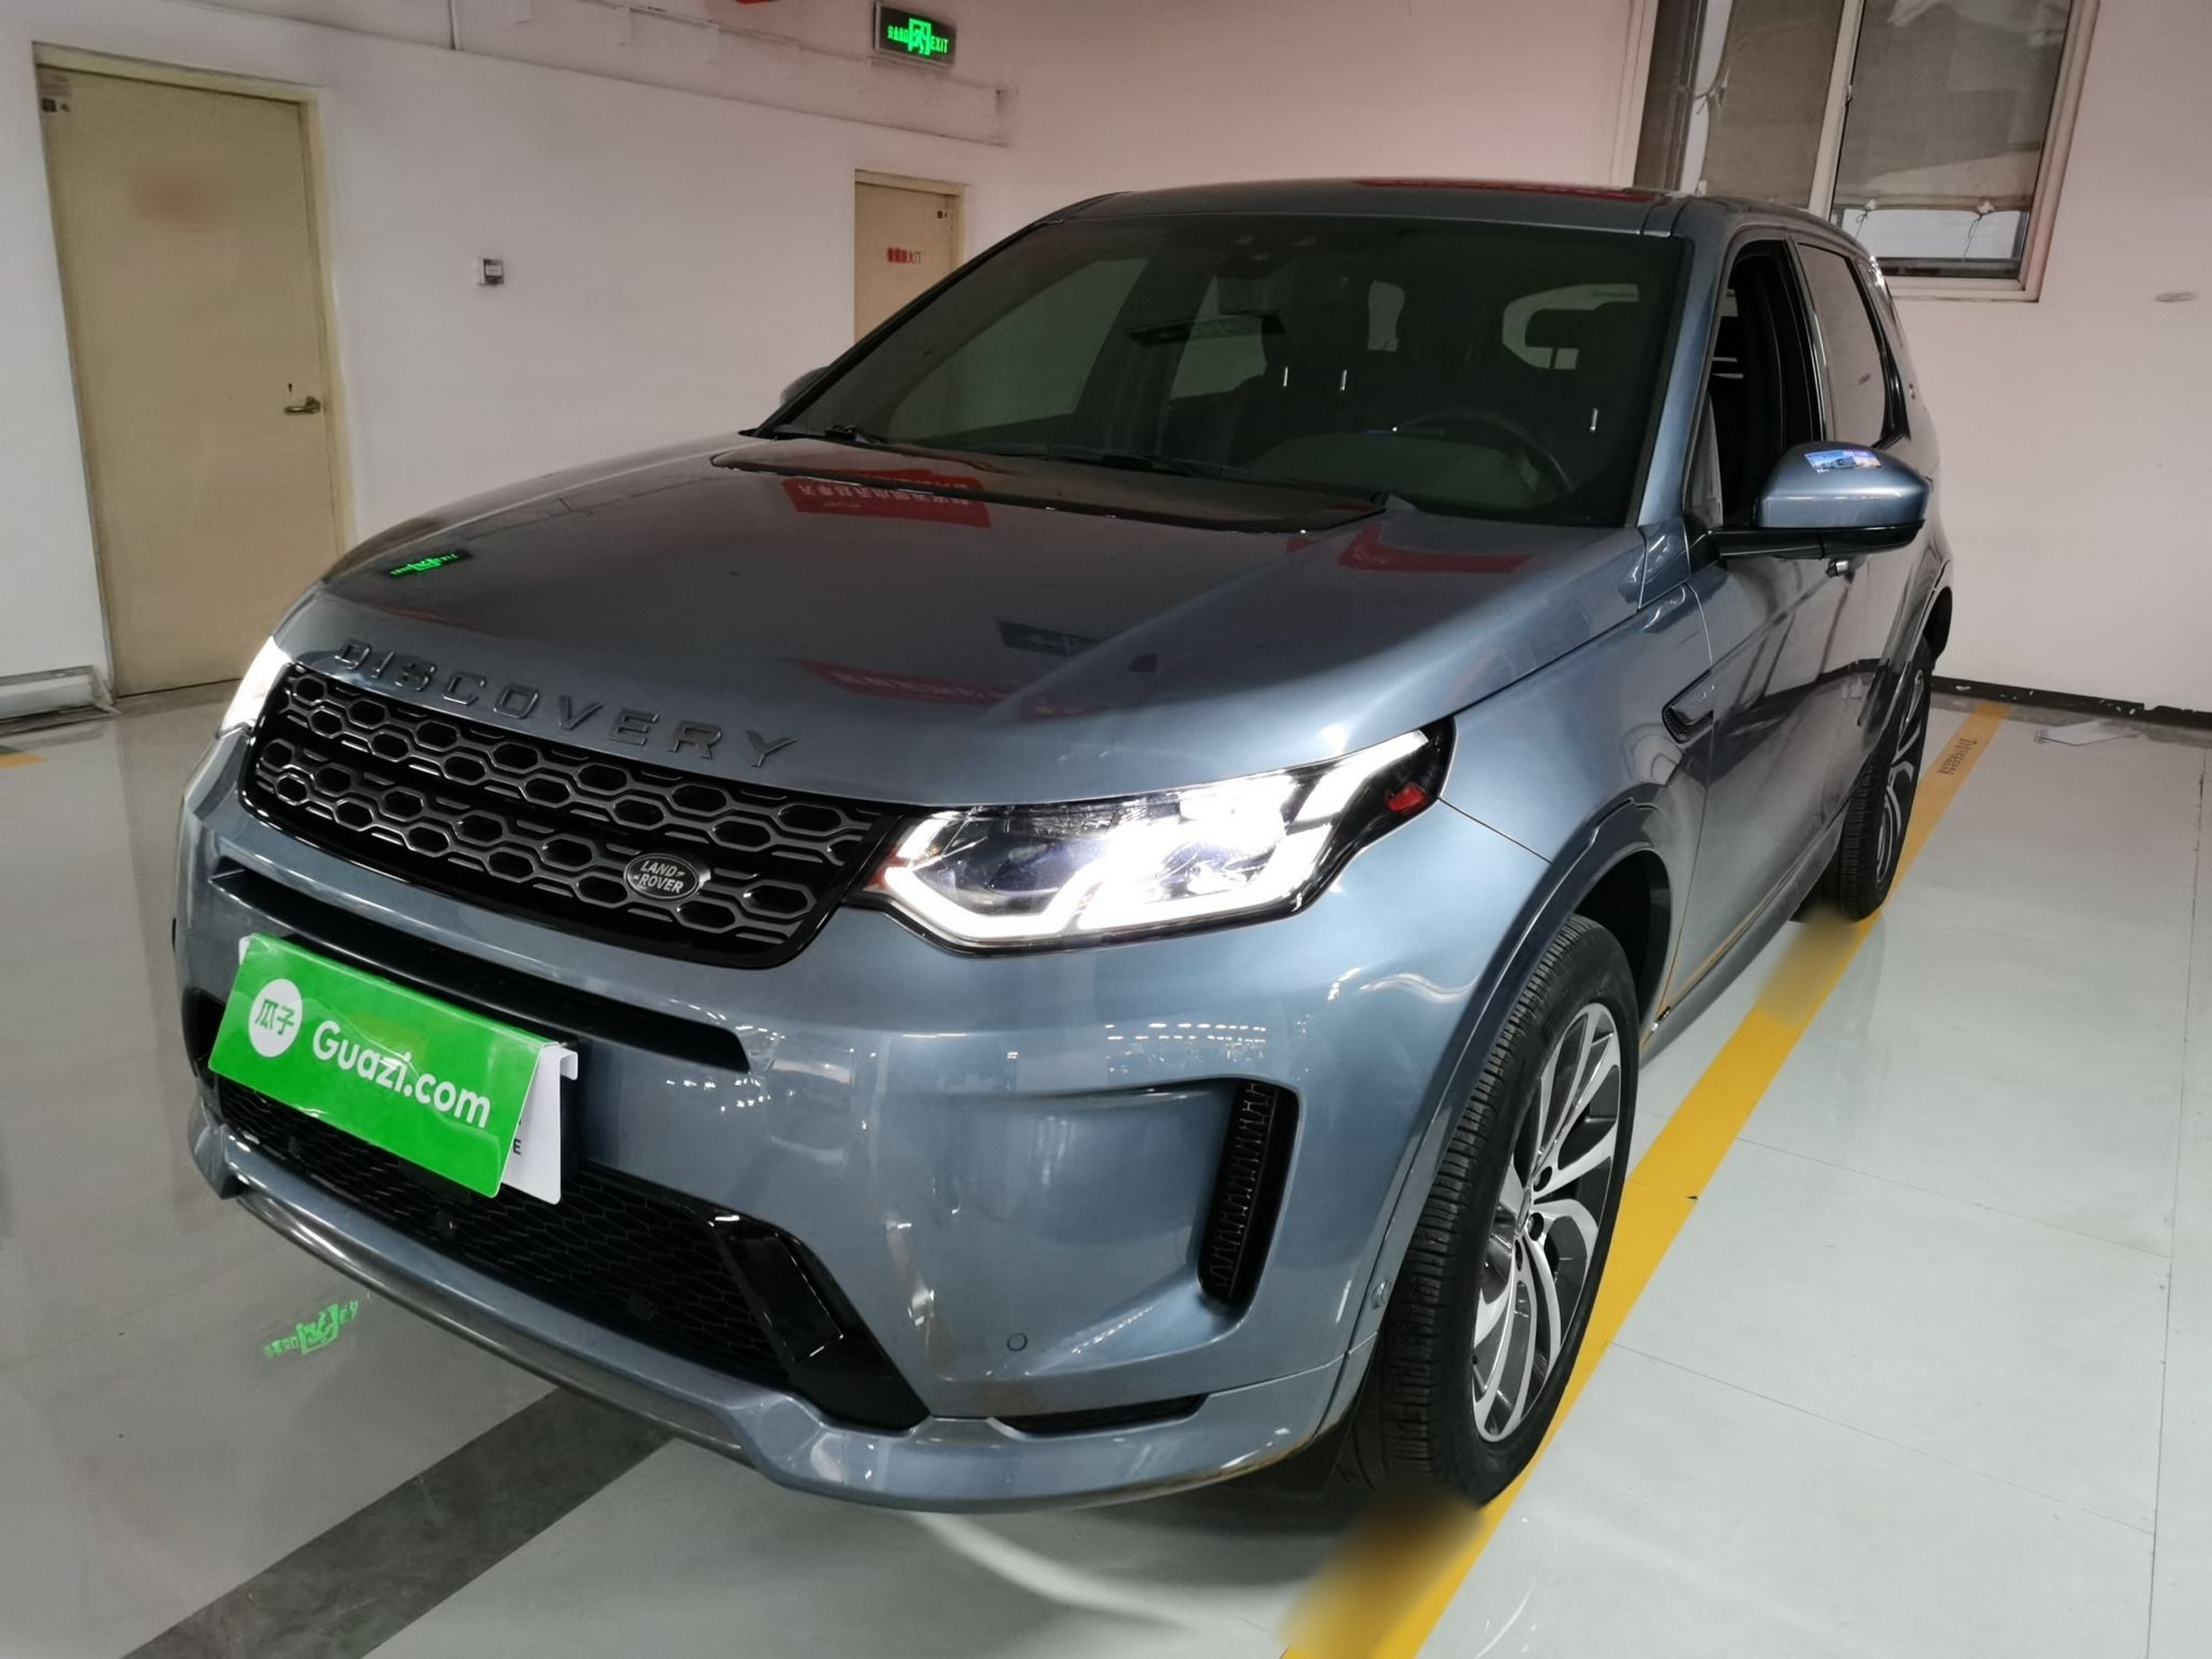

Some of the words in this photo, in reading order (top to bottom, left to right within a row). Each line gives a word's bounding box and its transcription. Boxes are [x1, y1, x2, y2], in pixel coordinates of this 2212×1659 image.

[930, 36, 949, 54] EXIT
[333, 638, 797, 767] DISCOVERY
[639, 873, 684, 893] ROVER
[253, 997, 295, 1036] 瓜子
[312, 1020, 491, 1128] Guazi.com
